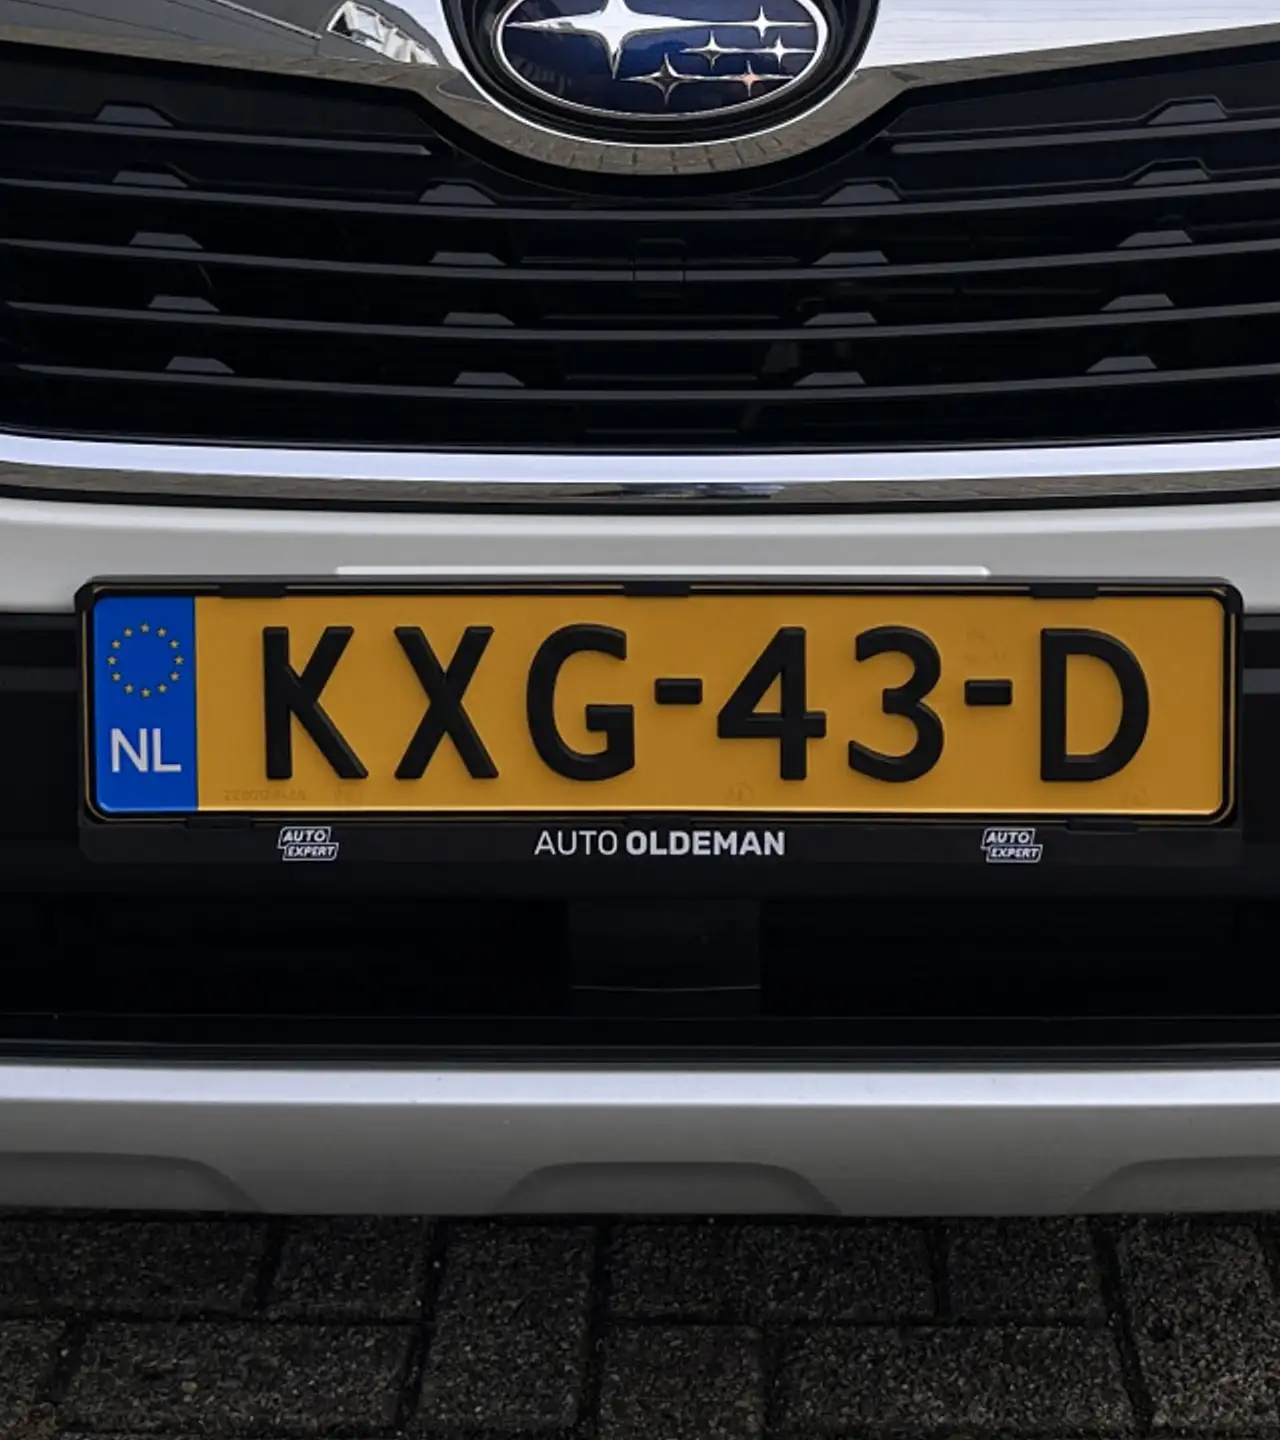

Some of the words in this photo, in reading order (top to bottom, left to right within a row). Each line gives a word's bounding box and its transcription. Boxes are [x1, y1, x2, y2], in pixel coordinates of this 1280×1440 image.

[263, 624, 1149, 782] KXG-43-D
[111, 727, 182, 773] NL
[284, 830, 326, 842] AUTO
[986, 831, 1030, 844] AUTO
[534, 830, 618, 856] AUTO
[625, 830, 785, 856] OLDEMAN
[288, 846, 335, 857] EXPERT
[990, 847, 1039, 858] EXPERT
